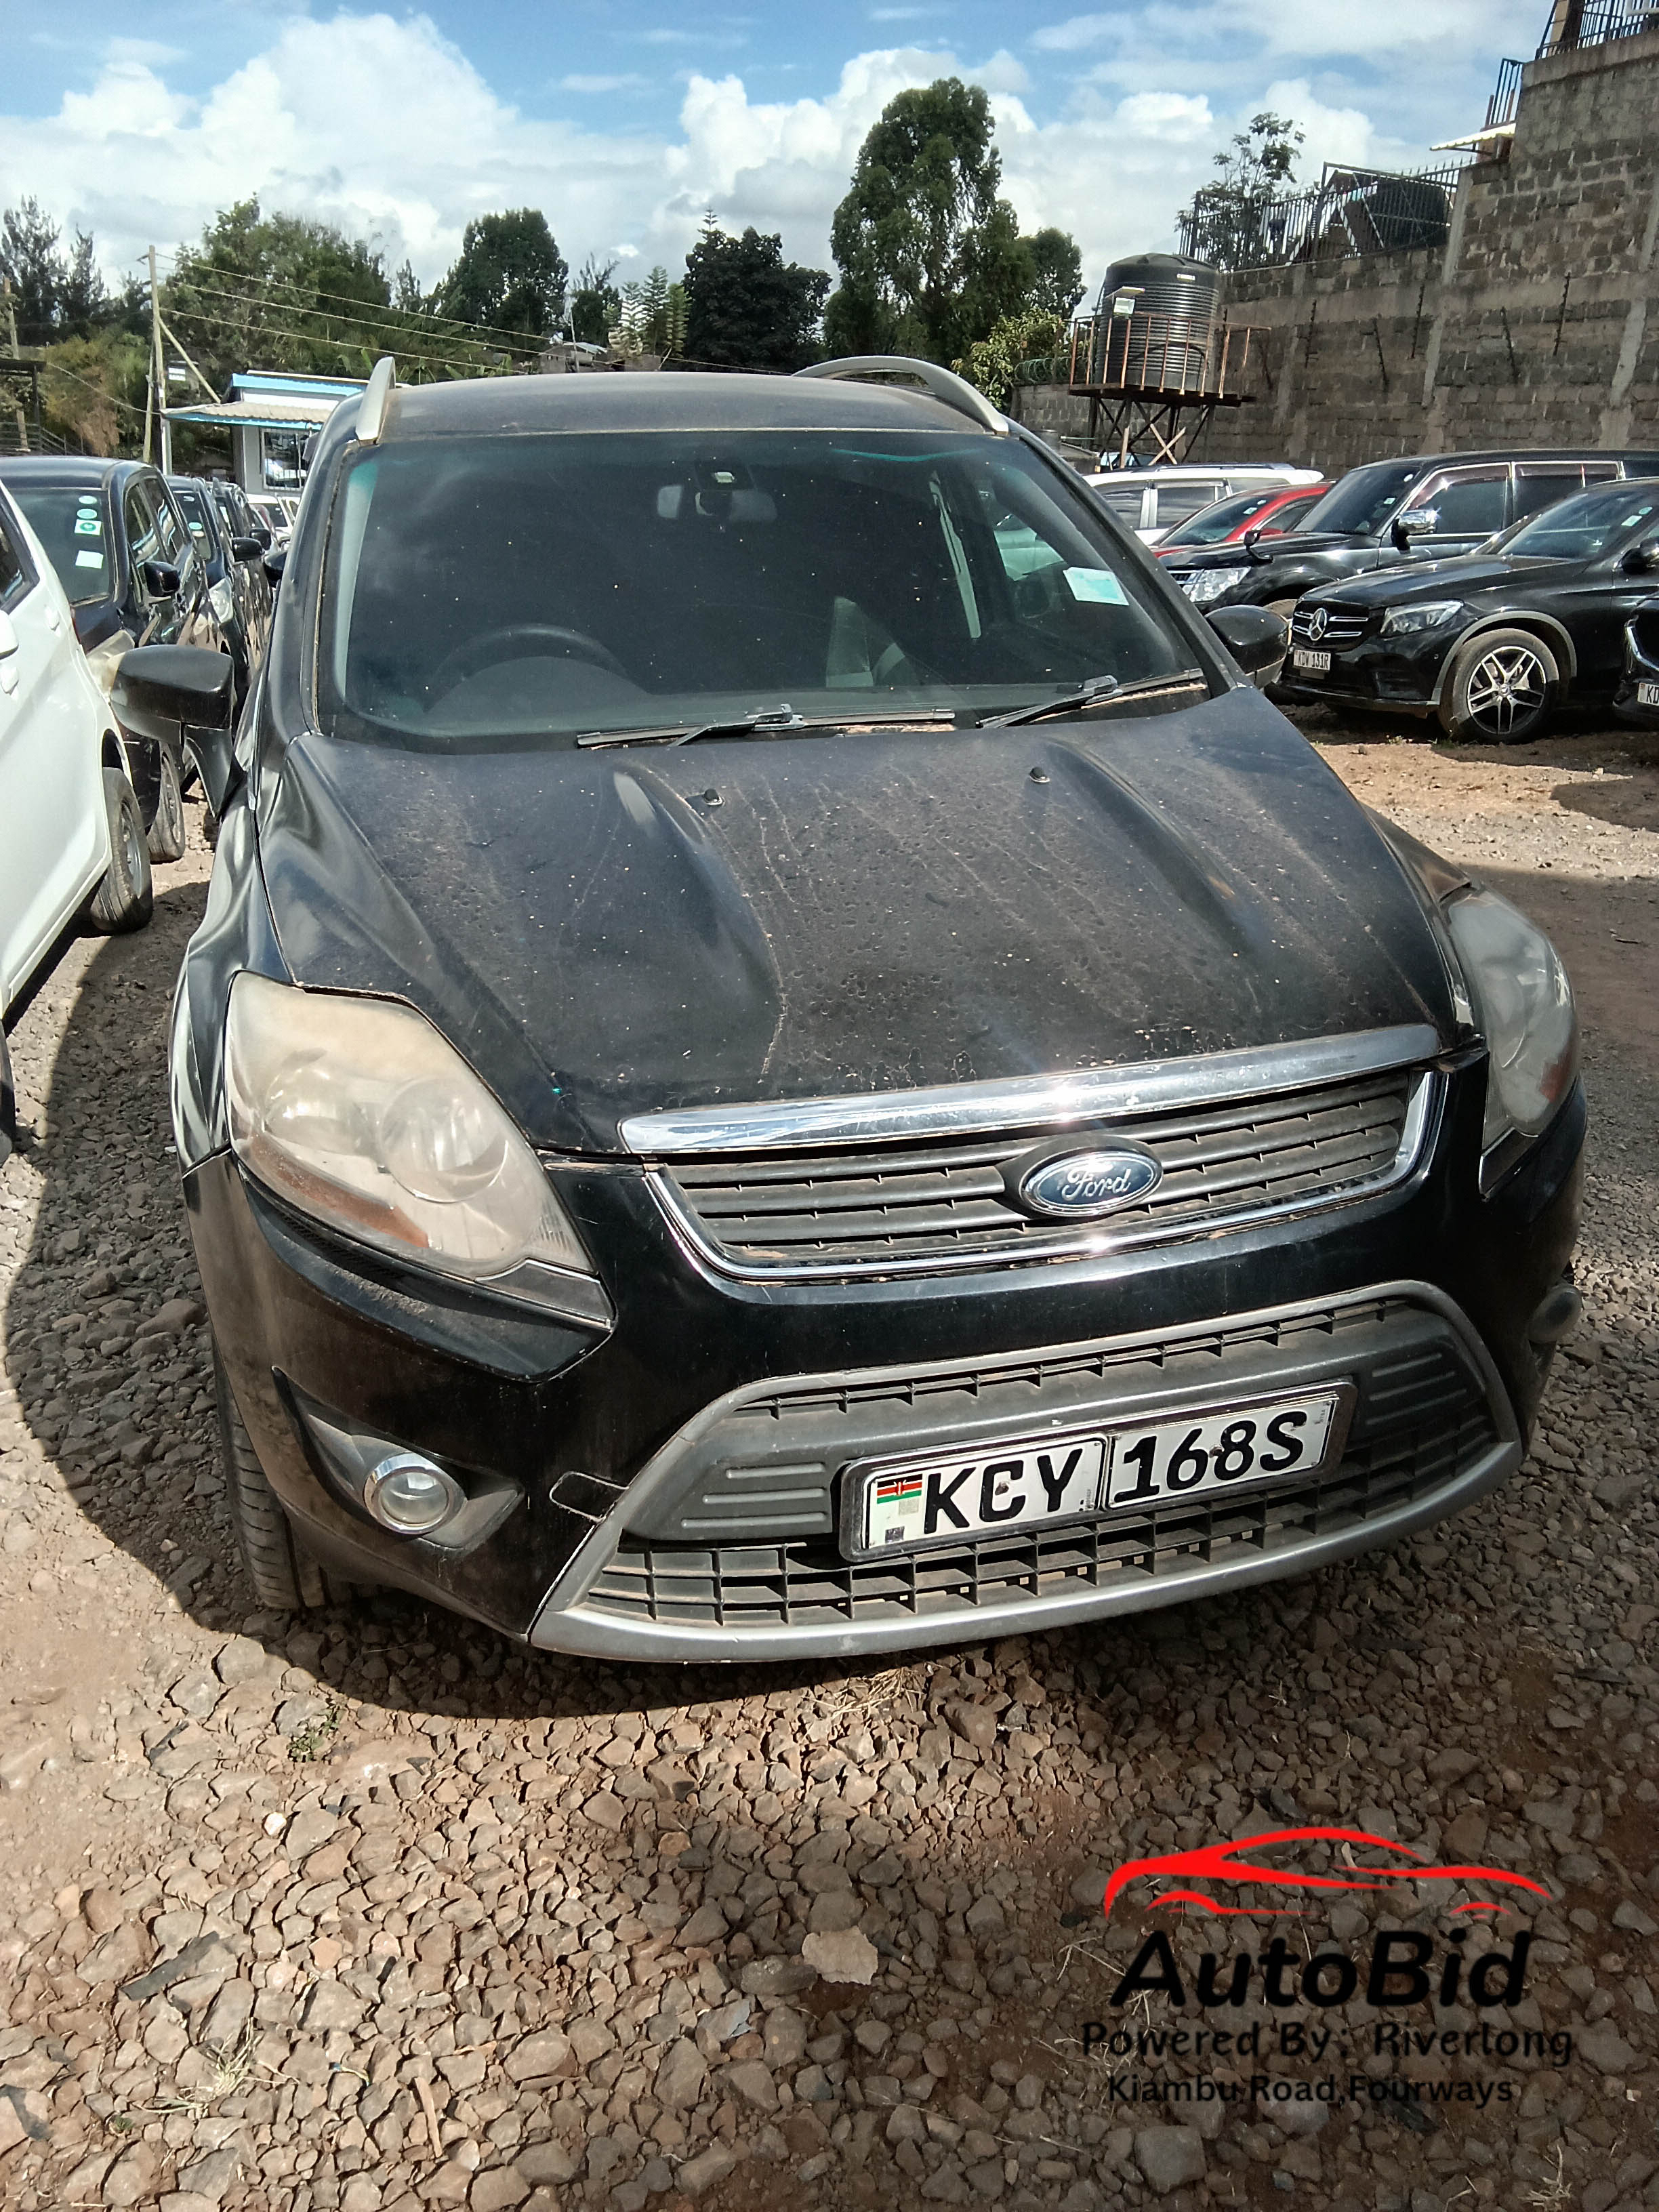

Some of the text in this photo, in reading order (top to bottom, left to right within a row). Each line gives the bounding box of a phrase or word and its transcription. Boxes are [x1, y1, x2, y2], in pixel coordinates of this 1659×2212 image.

[1312, 653, 1329, 669] 131R
[1061, 1163, 1131, 1201] Ford
[924, 1411, 1307, 1534] KCY 168S
